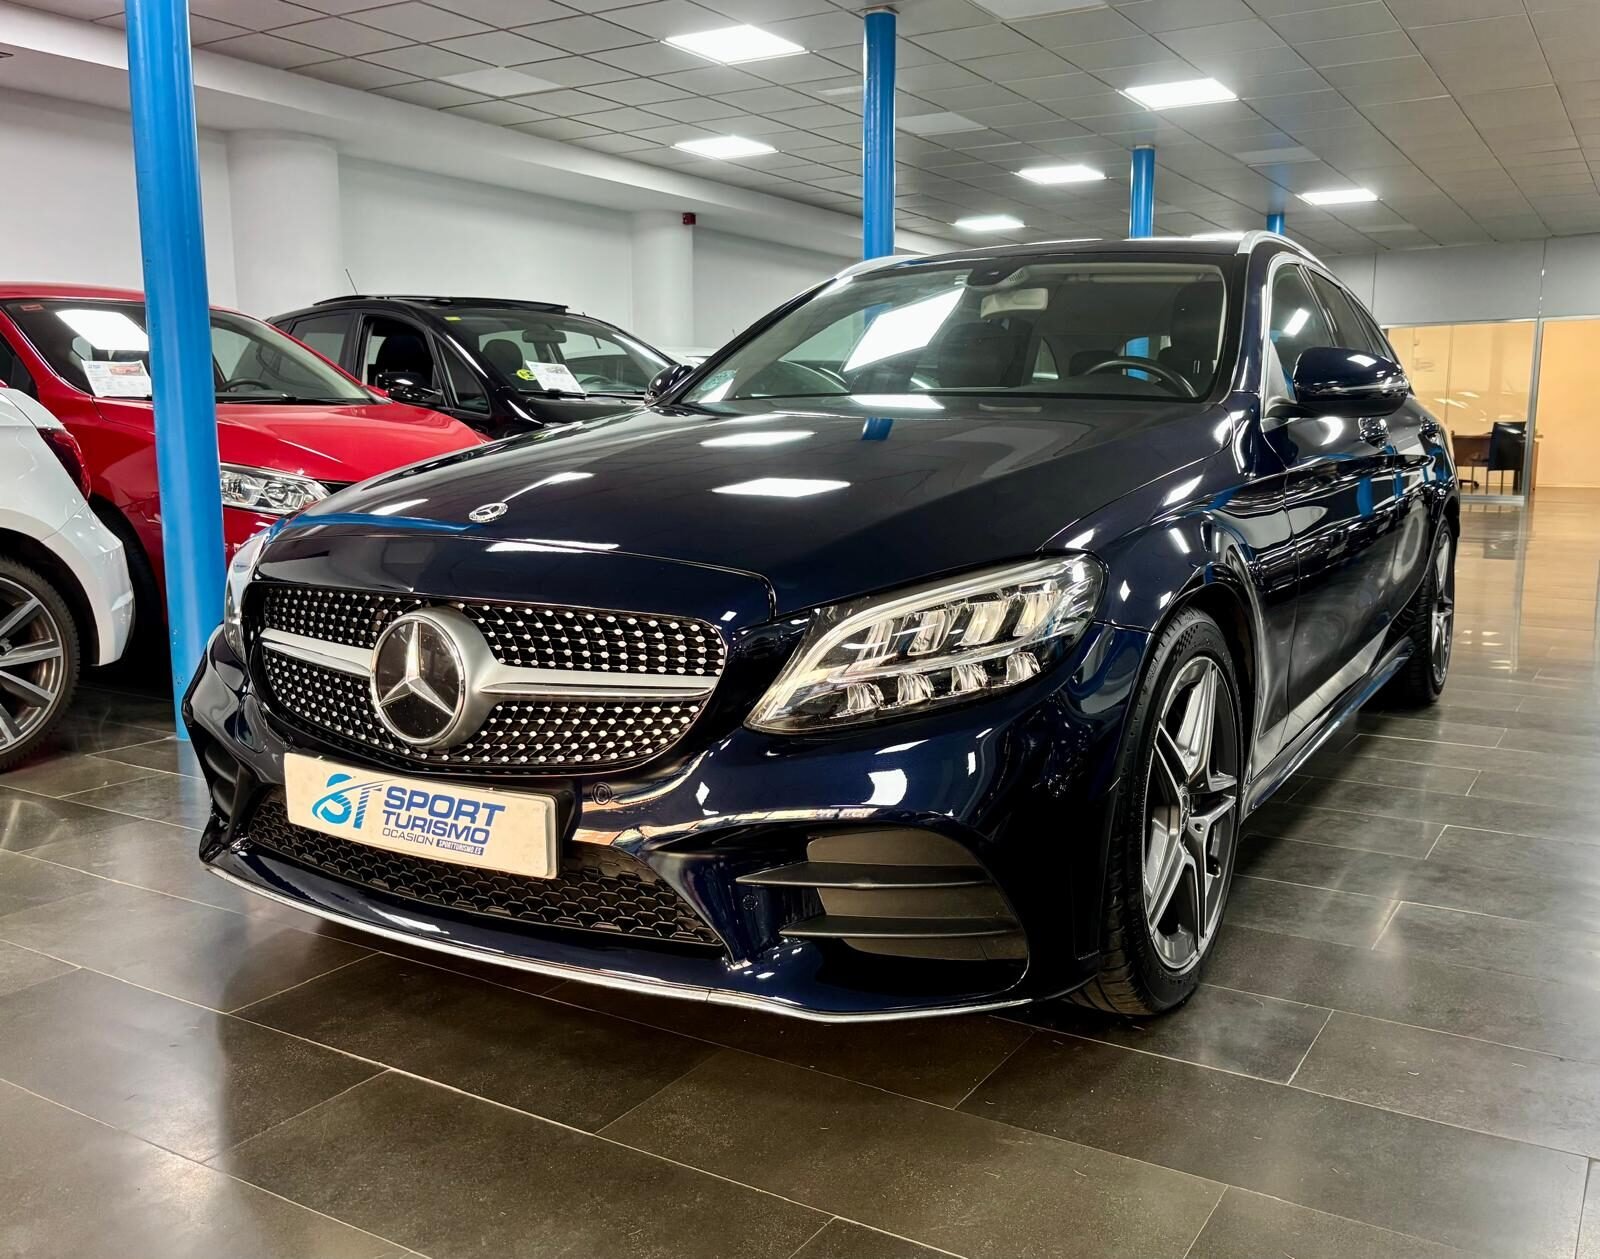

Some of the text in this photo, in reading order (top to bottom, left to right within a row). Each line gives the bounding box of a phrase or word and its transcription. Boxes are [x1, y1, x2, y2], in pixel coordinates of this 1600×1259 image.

[384, 786, 506, 827] SPORT
[382, 810, 490, 845] TURISMO
[382, 828, 434, 845] OCASION
